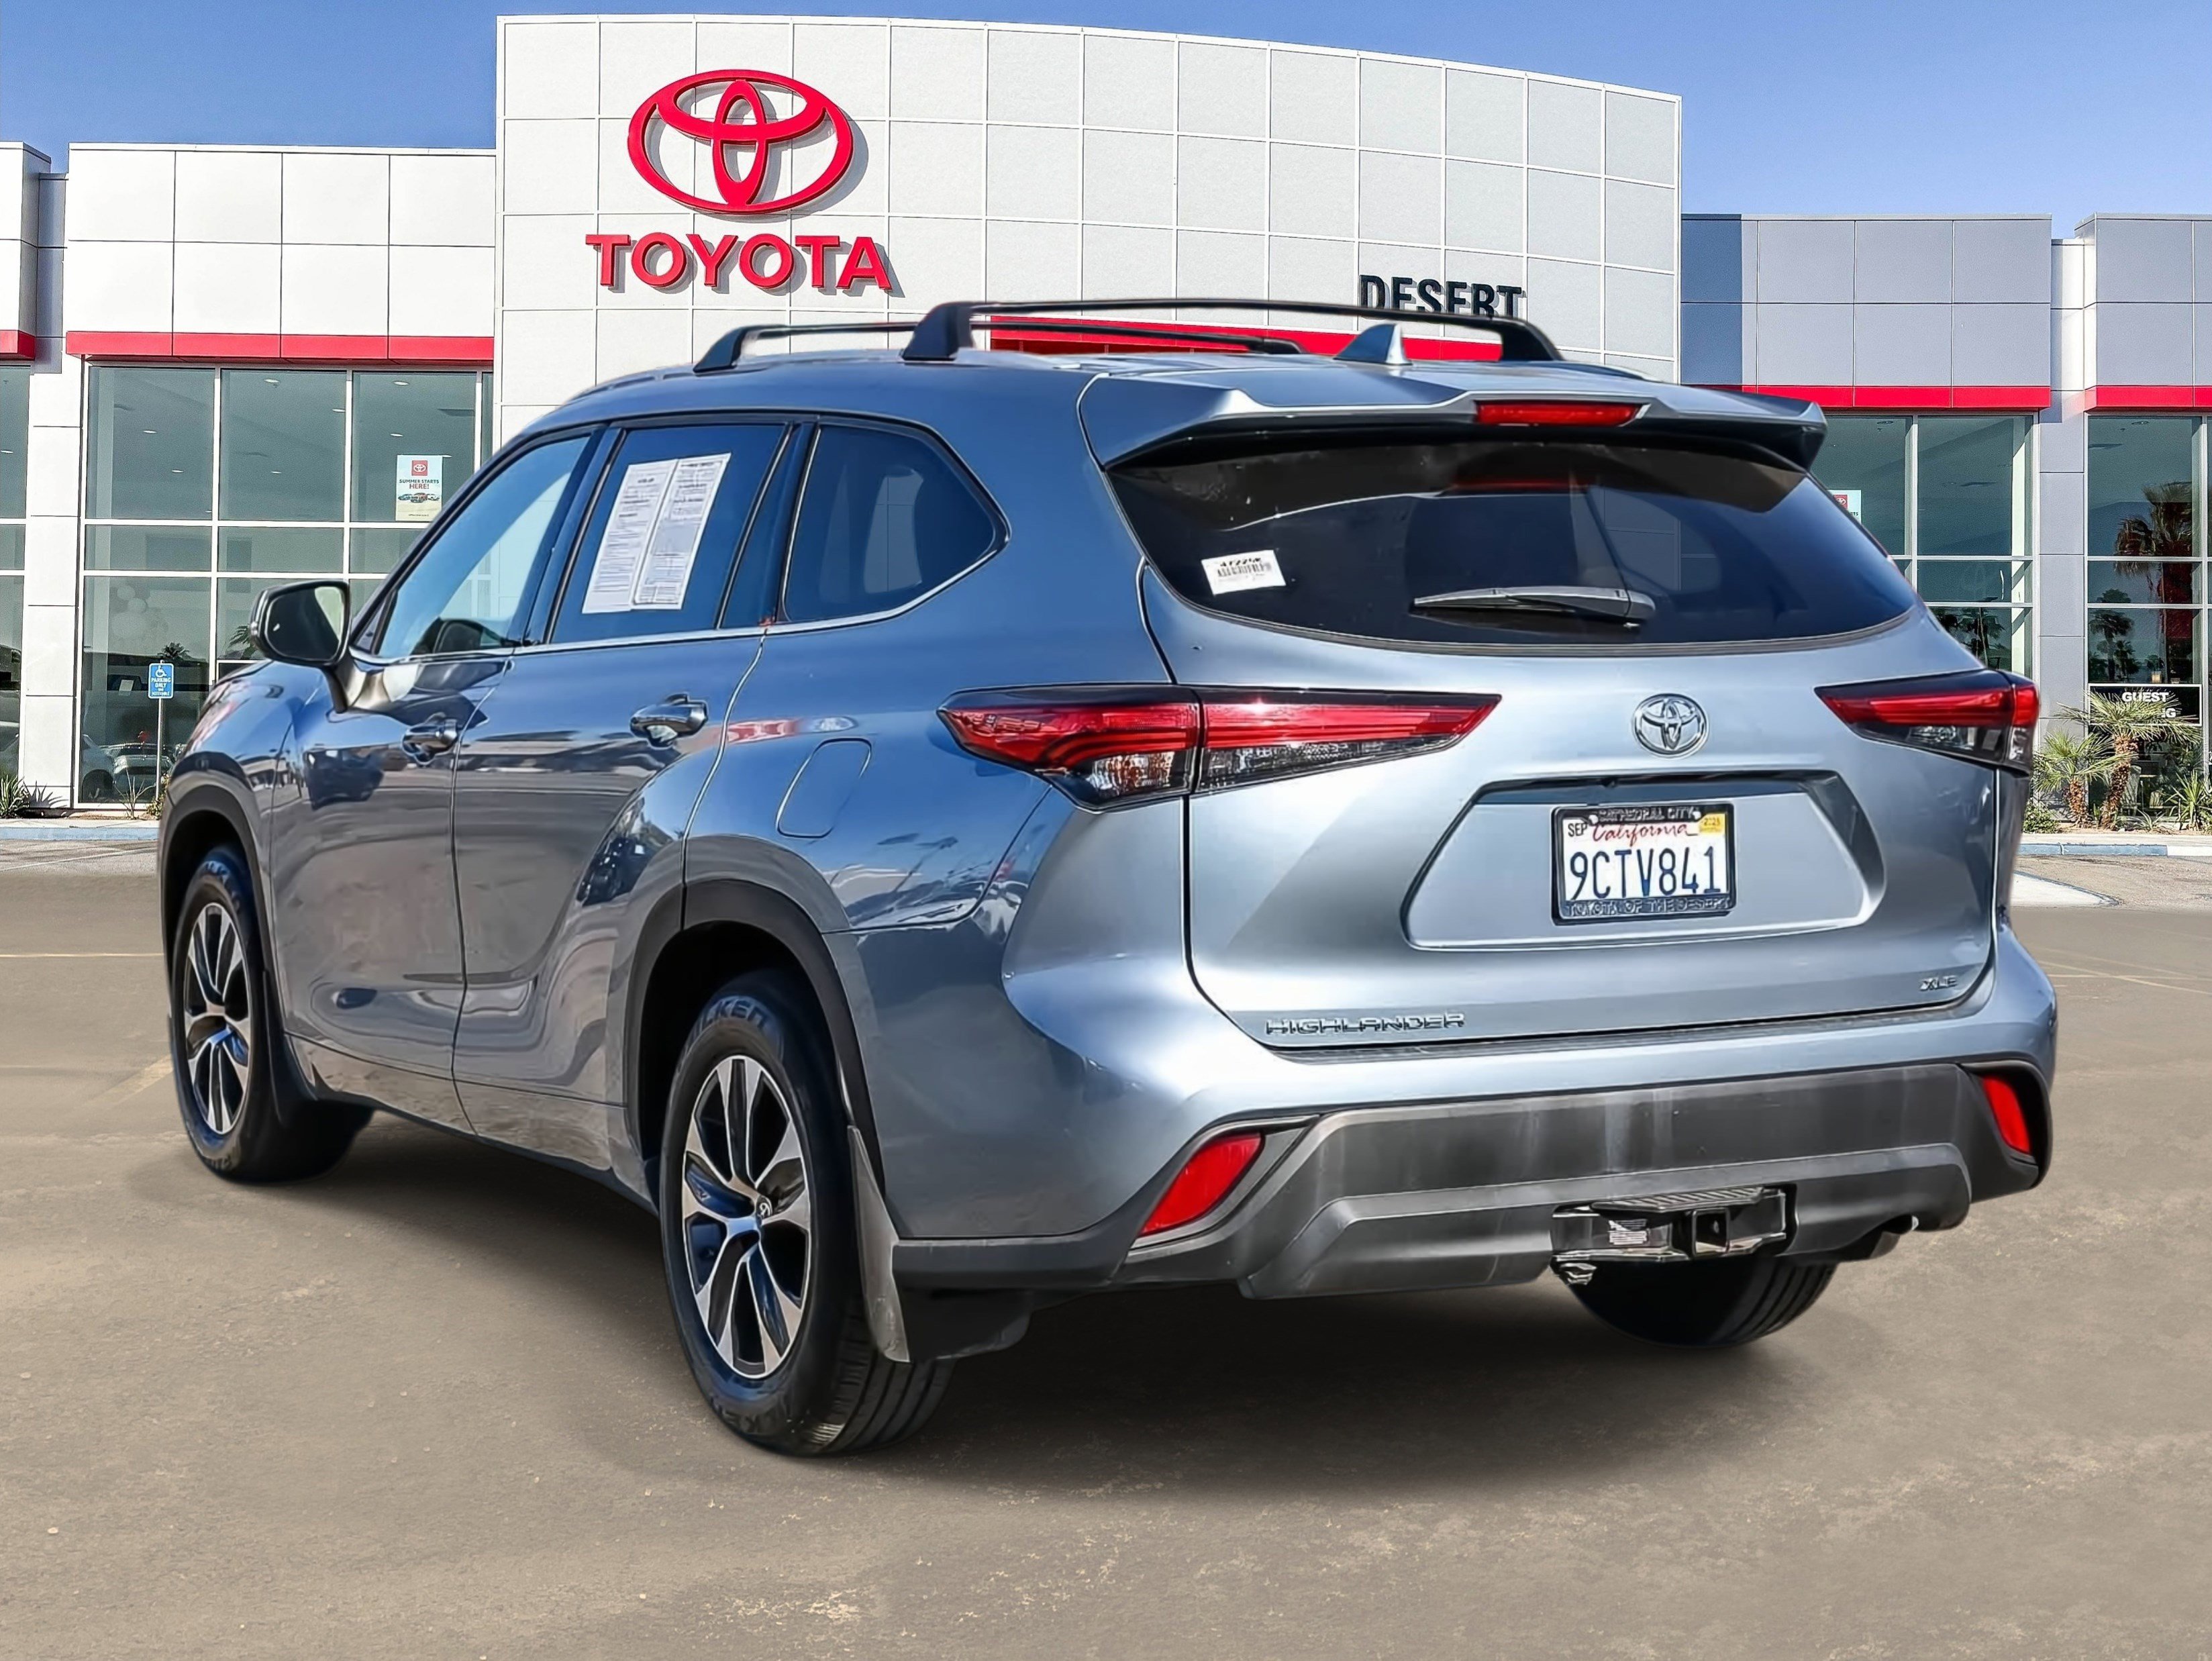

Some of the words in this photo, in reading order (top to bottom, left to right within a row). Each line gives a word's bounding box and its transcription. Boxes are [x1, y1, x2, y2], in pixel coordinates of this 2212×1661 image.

[586, 232, 892, 290] TOYOTA
[1360, 274, 1521, 318] DESERT
[2122, 691, 2169, 703] GUEST
[1668, 806, 1694, 819] CITY
[1568, 823, 1588, 837] SEP
[1593, 823, 1691, 847] California
[1570, 846, 1721, 901] 9CTV841
[1624, 899, 1643, 913] OF
[1648, 898, 1674, 913] THE
[1920, 975, 1958, 991] XLE
[1266, 1010, 1465, 1035] HIGHLANDER
